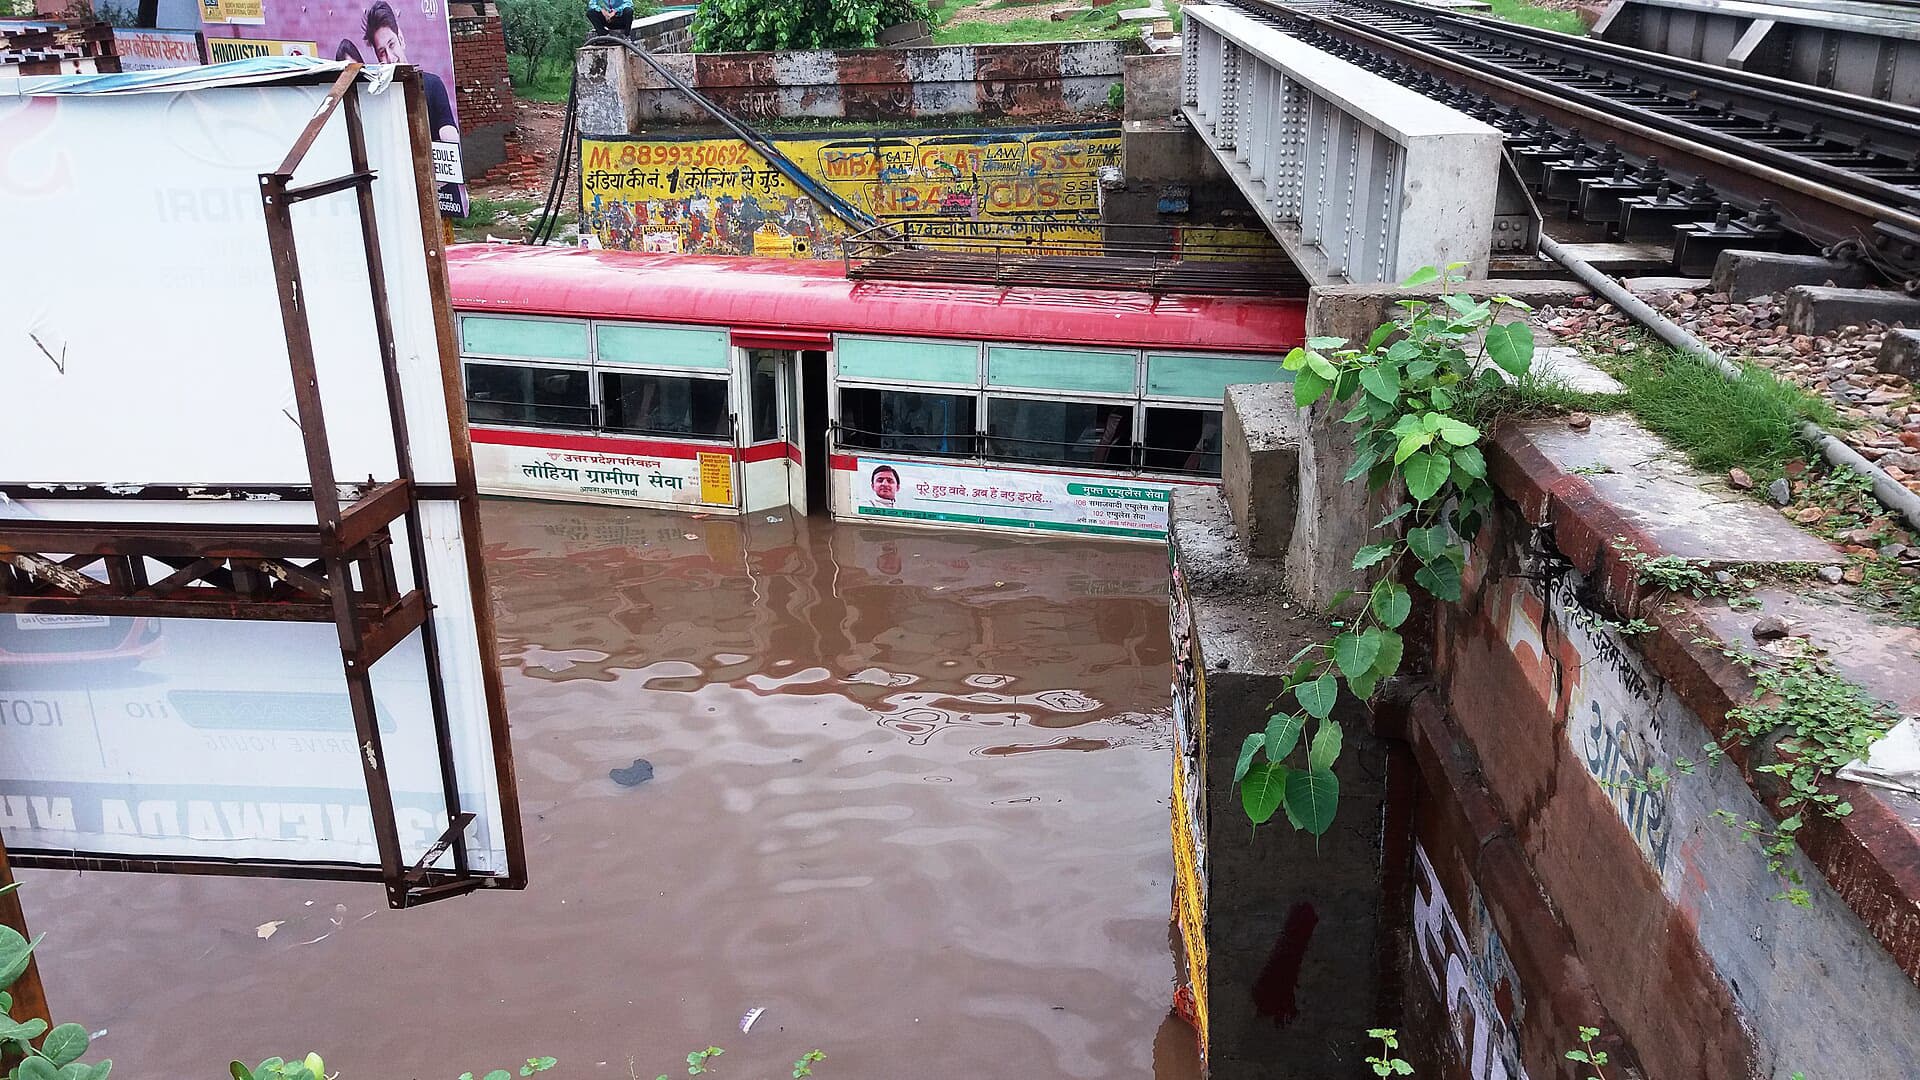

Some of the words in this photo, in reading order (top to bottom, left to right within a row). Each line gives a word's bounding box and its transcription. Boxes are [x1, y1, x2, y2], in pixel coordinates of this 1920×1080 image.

[210, 42, 270, 63] HINDUSTAN
[432, 148, 458, 163] EDULE.
[885, 151, 912, 162] CAT
[985, 146, 1019, 159] LAW
[1086, 144, 1122, 155] BANK
[825, 151, 884, 176] MBA
[1029, 146, 1086, 170] SSC
[434, 163, 456, 177] ENCE.
[585, 169, 626, 195] इंडिया
[666, 166, 680, 194] 1
[991, 181, 1060, 208] CDS
[563, 453, 590, 463] उत्तर
[590, 454, 616, 466] प्रदेश
[616, 455, 661, 468] परिवहन
[521, 461, 579, 482] लोहिया
[585, 467, 641, 487] ग्रामीण
[647, 471, 684, 490] सेवा
[1145, 489, 1165, 500] सेवा
